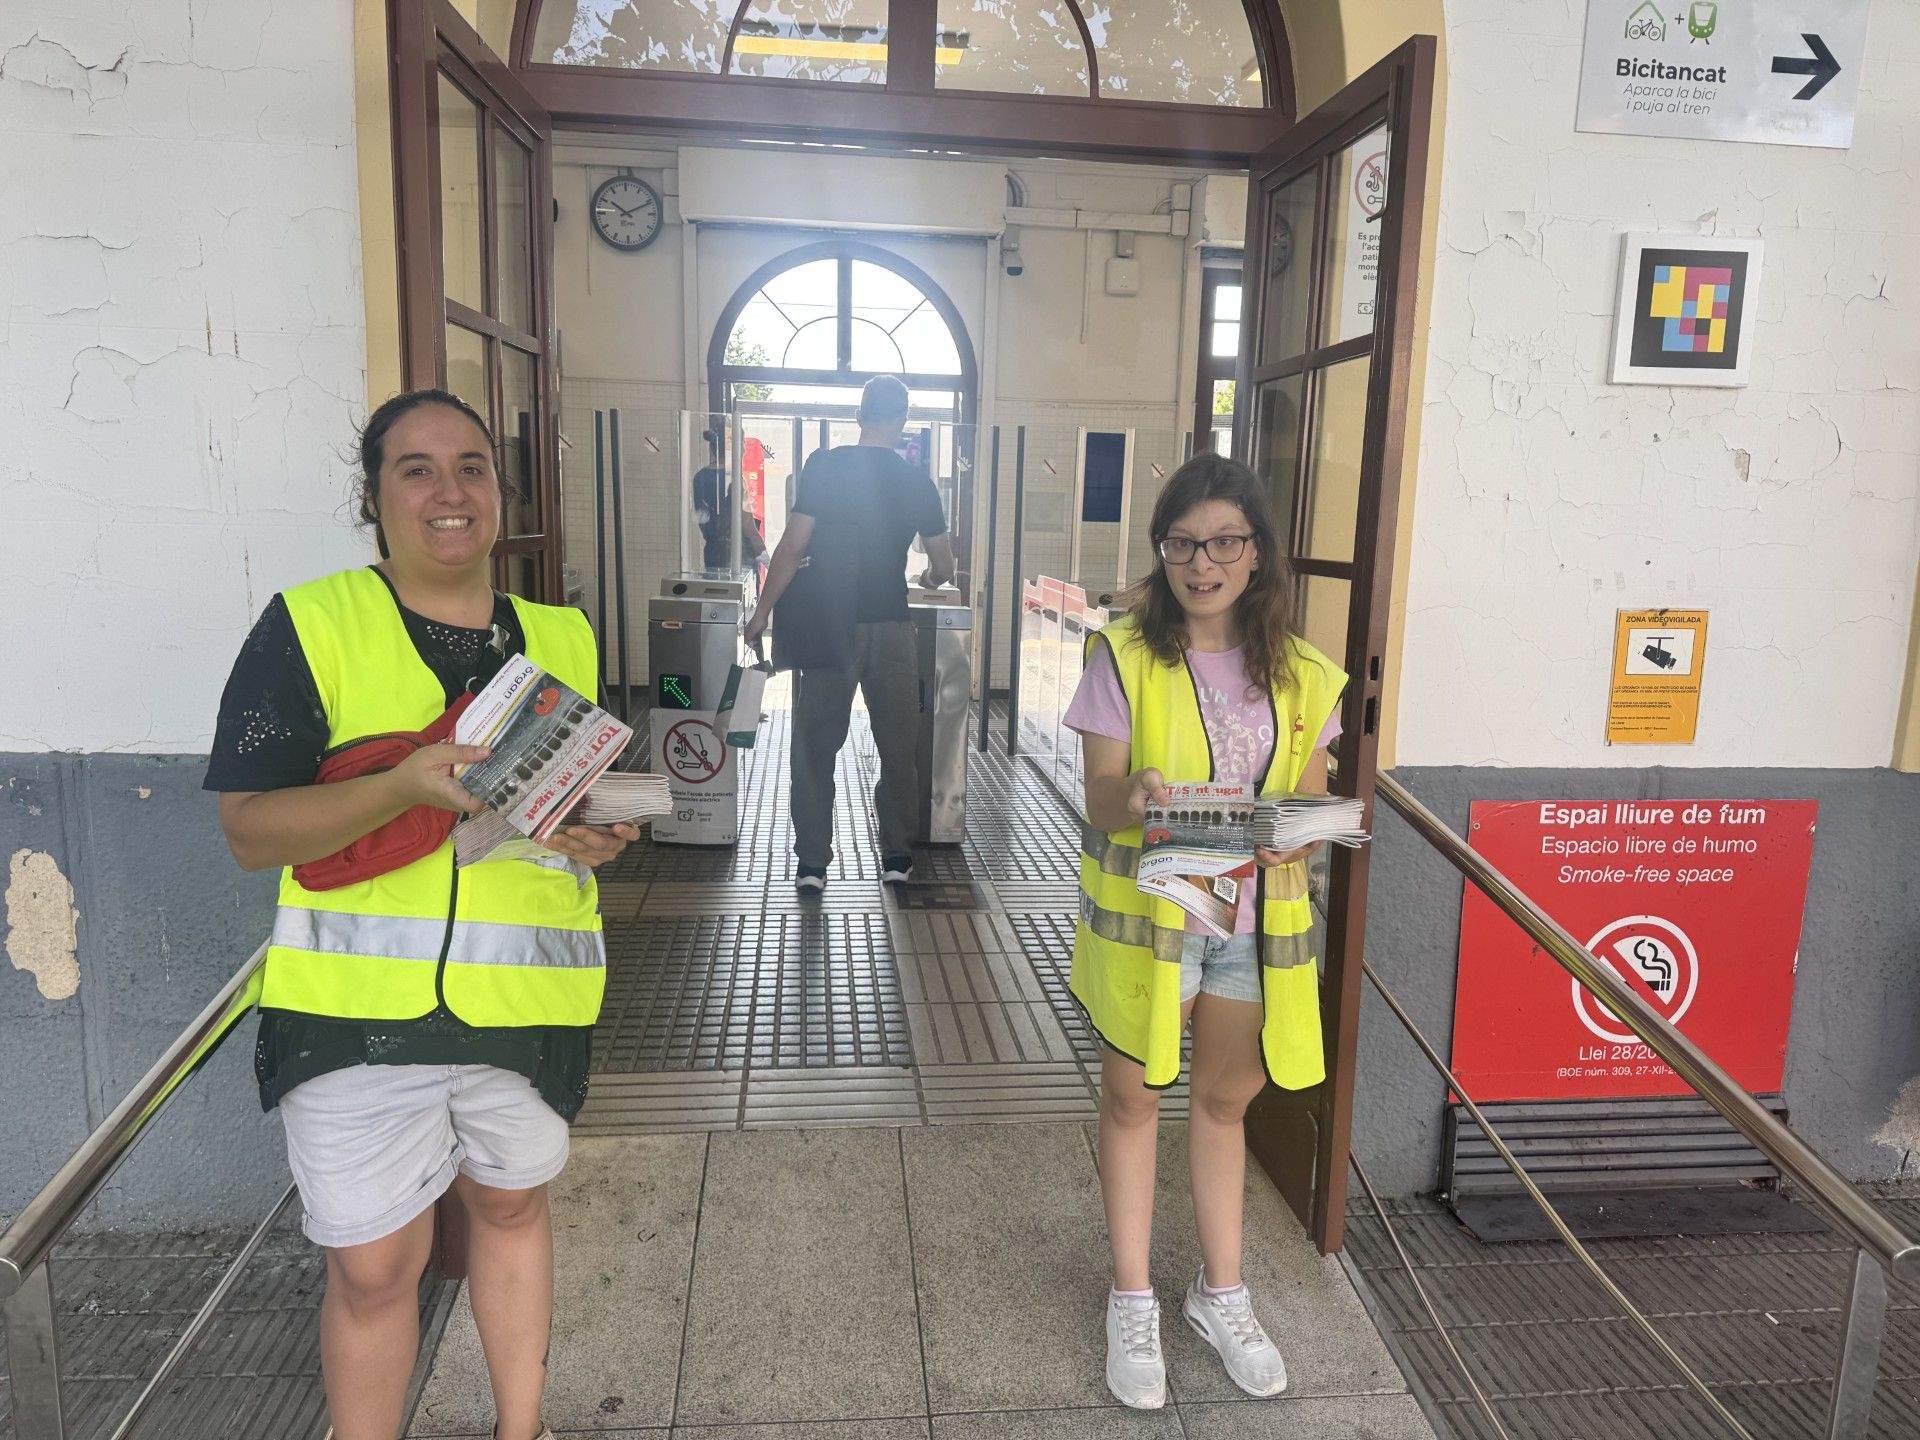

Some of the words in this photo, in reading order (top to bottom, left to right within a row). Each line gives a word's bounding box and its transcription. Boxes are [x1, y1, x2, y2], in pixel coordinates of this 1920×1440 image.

[1616, 57, 1727, 83] Bicitancat
[1623, 82, 1673, 98] Aparca
[1676, 86, 1690, 98] la
[1693, 87, 1718, 100] bici
[1626, 98, 1632, 109] i
[1633, 99, 1664, 115] puja
[1667, 101, 1681, 113] al
[1683, 103, 1711, 115] tren
[1357, 232, 1368, 240] Es
[1648, 616, 1702, 624] VIDEOVIGILADA
[591, 725, 622, 757] TOT
[1539, 803, 1608, 828] Espai
[1614, 803, 1675, 825] lliure
[1681, 803, 1712, 825] de
[1719, 803, 1766, 825] fum
[1541, 835, 1620, 858] Espacio
[1625, 835, 1667, 854] libre
[1672, 835, 1697, 854] de
[1702, 835, 1758, 854] humo
[1557, 865, 1671, 883] Smoke-free
[1675, 867, 1735, 886] space
[1580, 1045, 1607, 1061] Llei
[1556, 1067, 1583, 1079] (BOE
[1584, 1066, 1609, 1077] núm.
[1611, 1066, 1633, 1077] 309,
[1635, 1065, 1677, 1076] 27-XII-2
